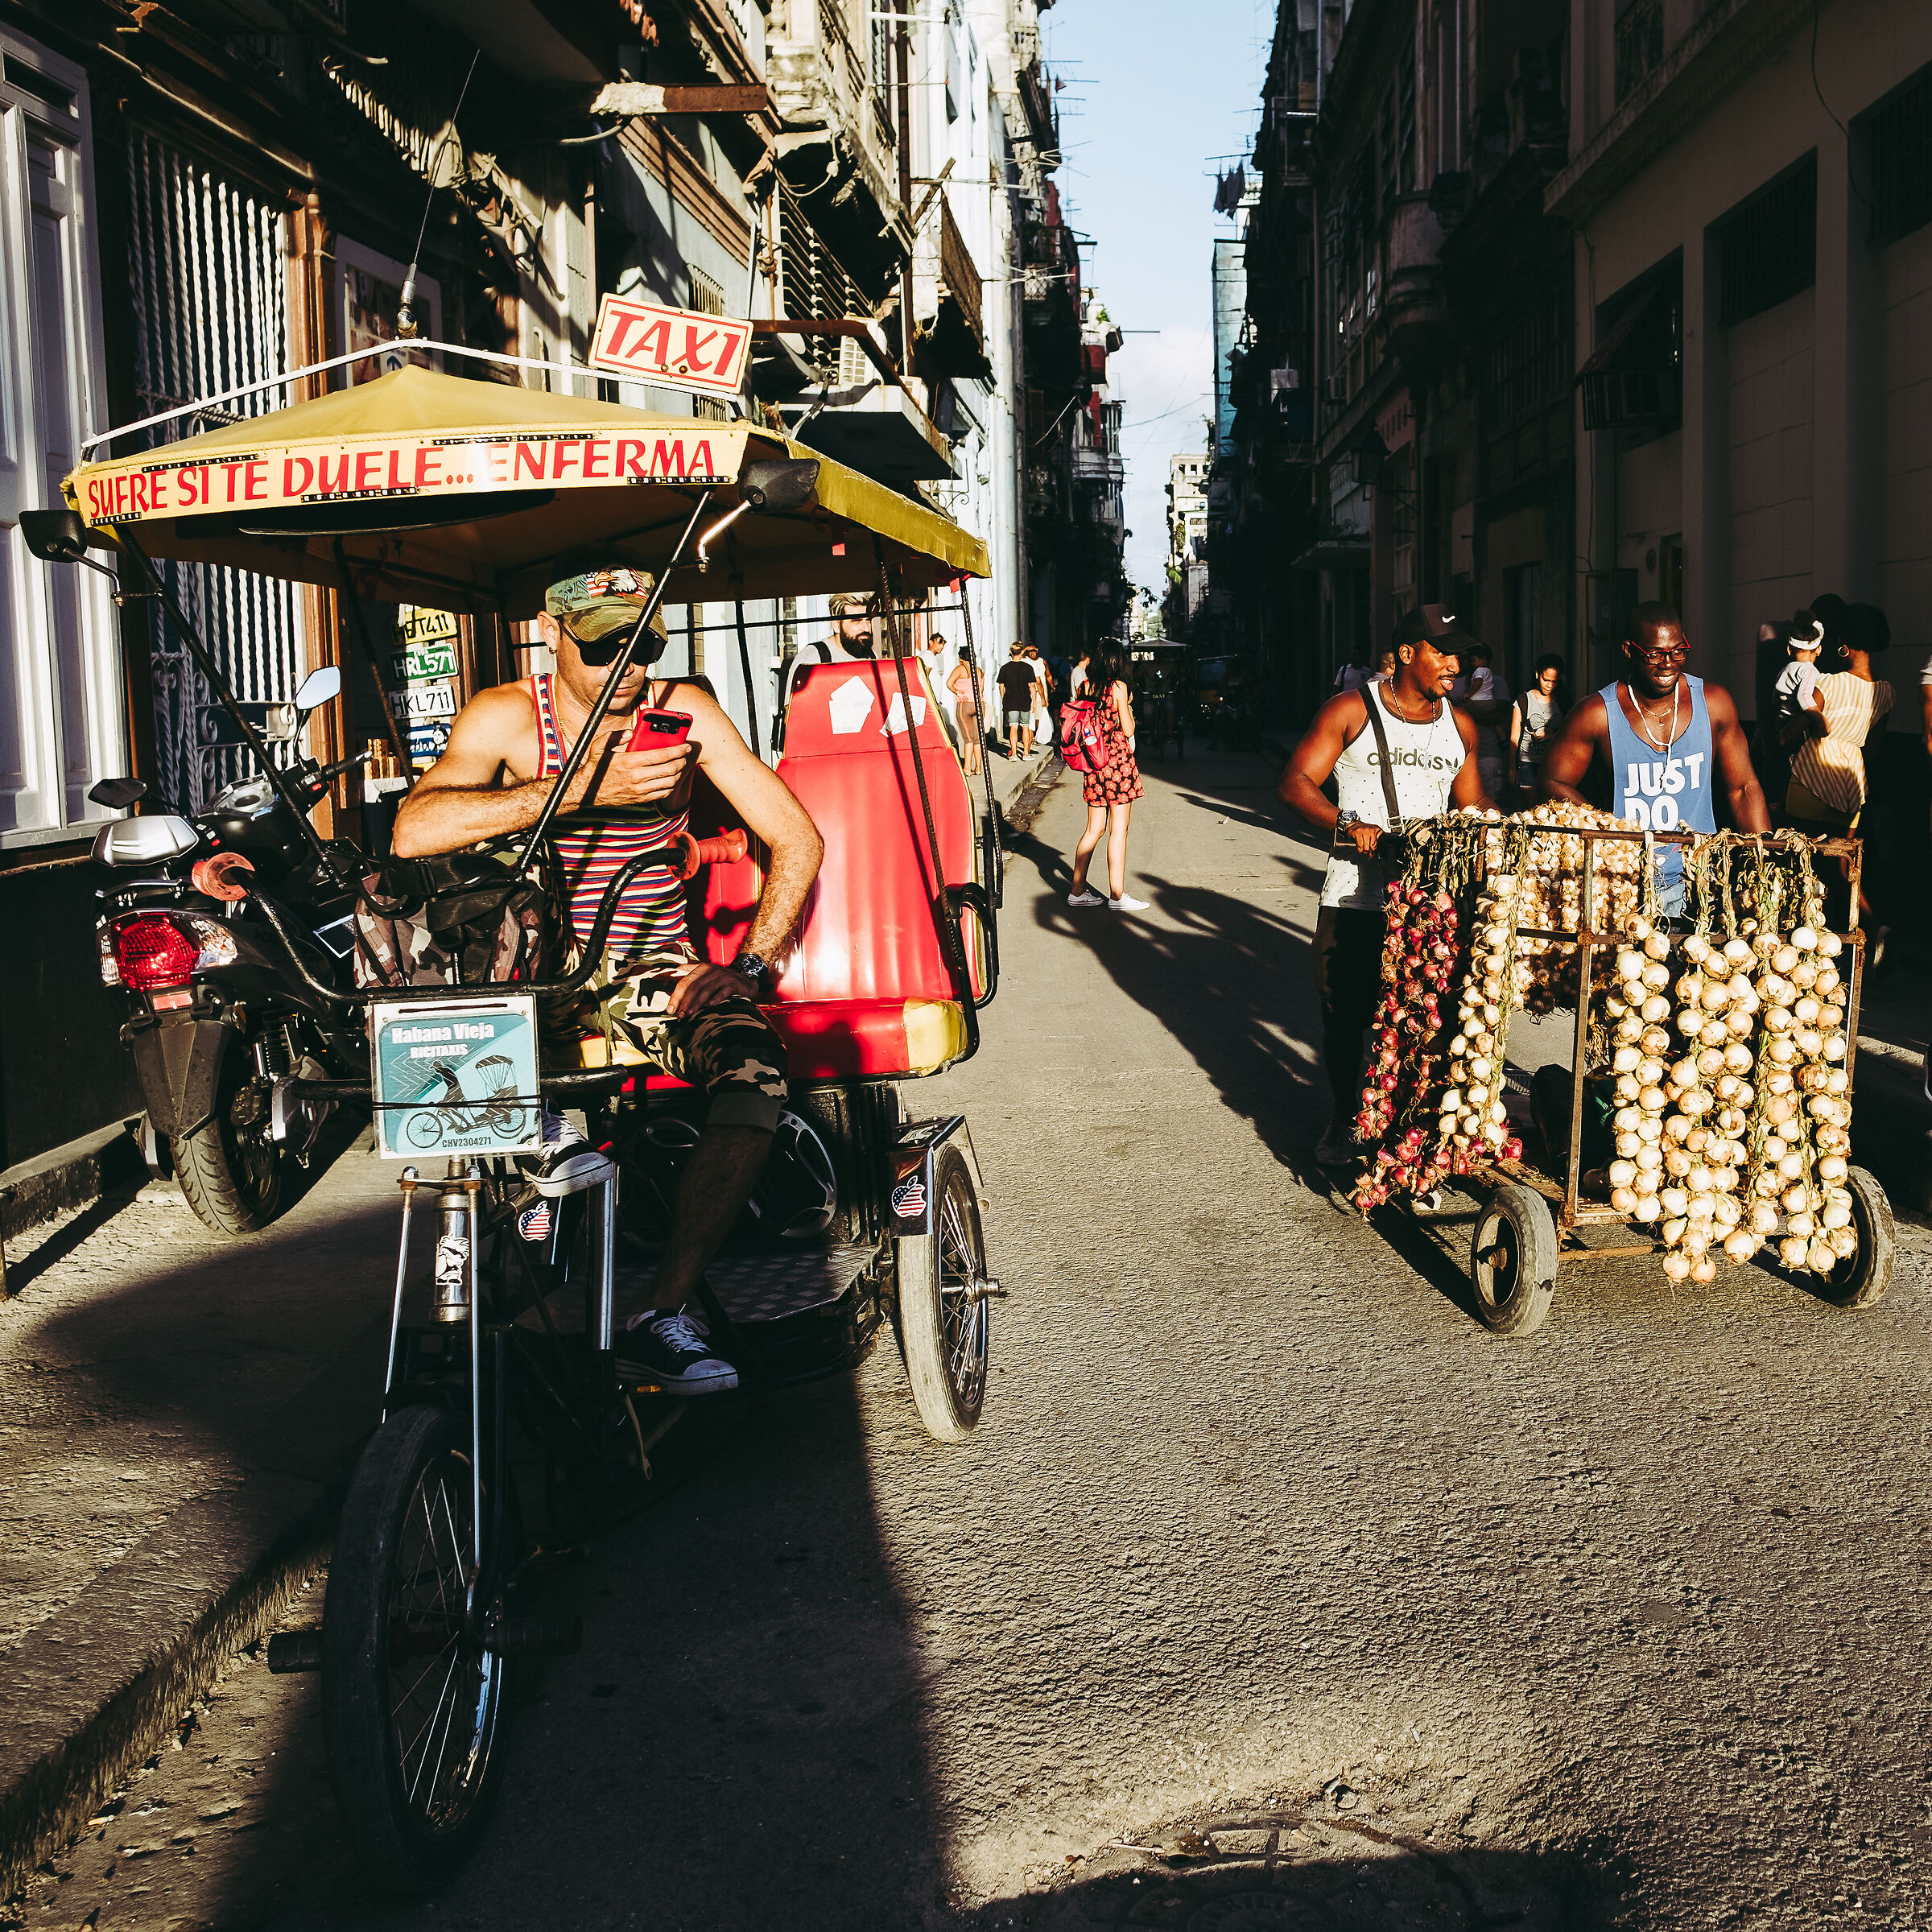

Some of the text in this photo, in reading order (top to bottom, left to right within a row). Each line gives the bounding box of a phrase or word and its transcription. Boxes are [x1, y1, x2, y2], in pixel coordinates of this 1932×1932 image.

[605, 310, 741, 376] TAXI
[89, 440, 715, 518] SUFRE SI TE DUELE... ENFERMA
[394, 650, 455, 678] HRL571
[390, 691, 450, 716] HKL711
[1624, 752, 1705, 797] JUST
[1624, 795, 1678, 831] DO
[392, 1022, 495, 1044] Habana Vieja
[410, 1043, 469, 1059] BICITAXIS
[442, 1137, 492, 1148] CHV2304271
